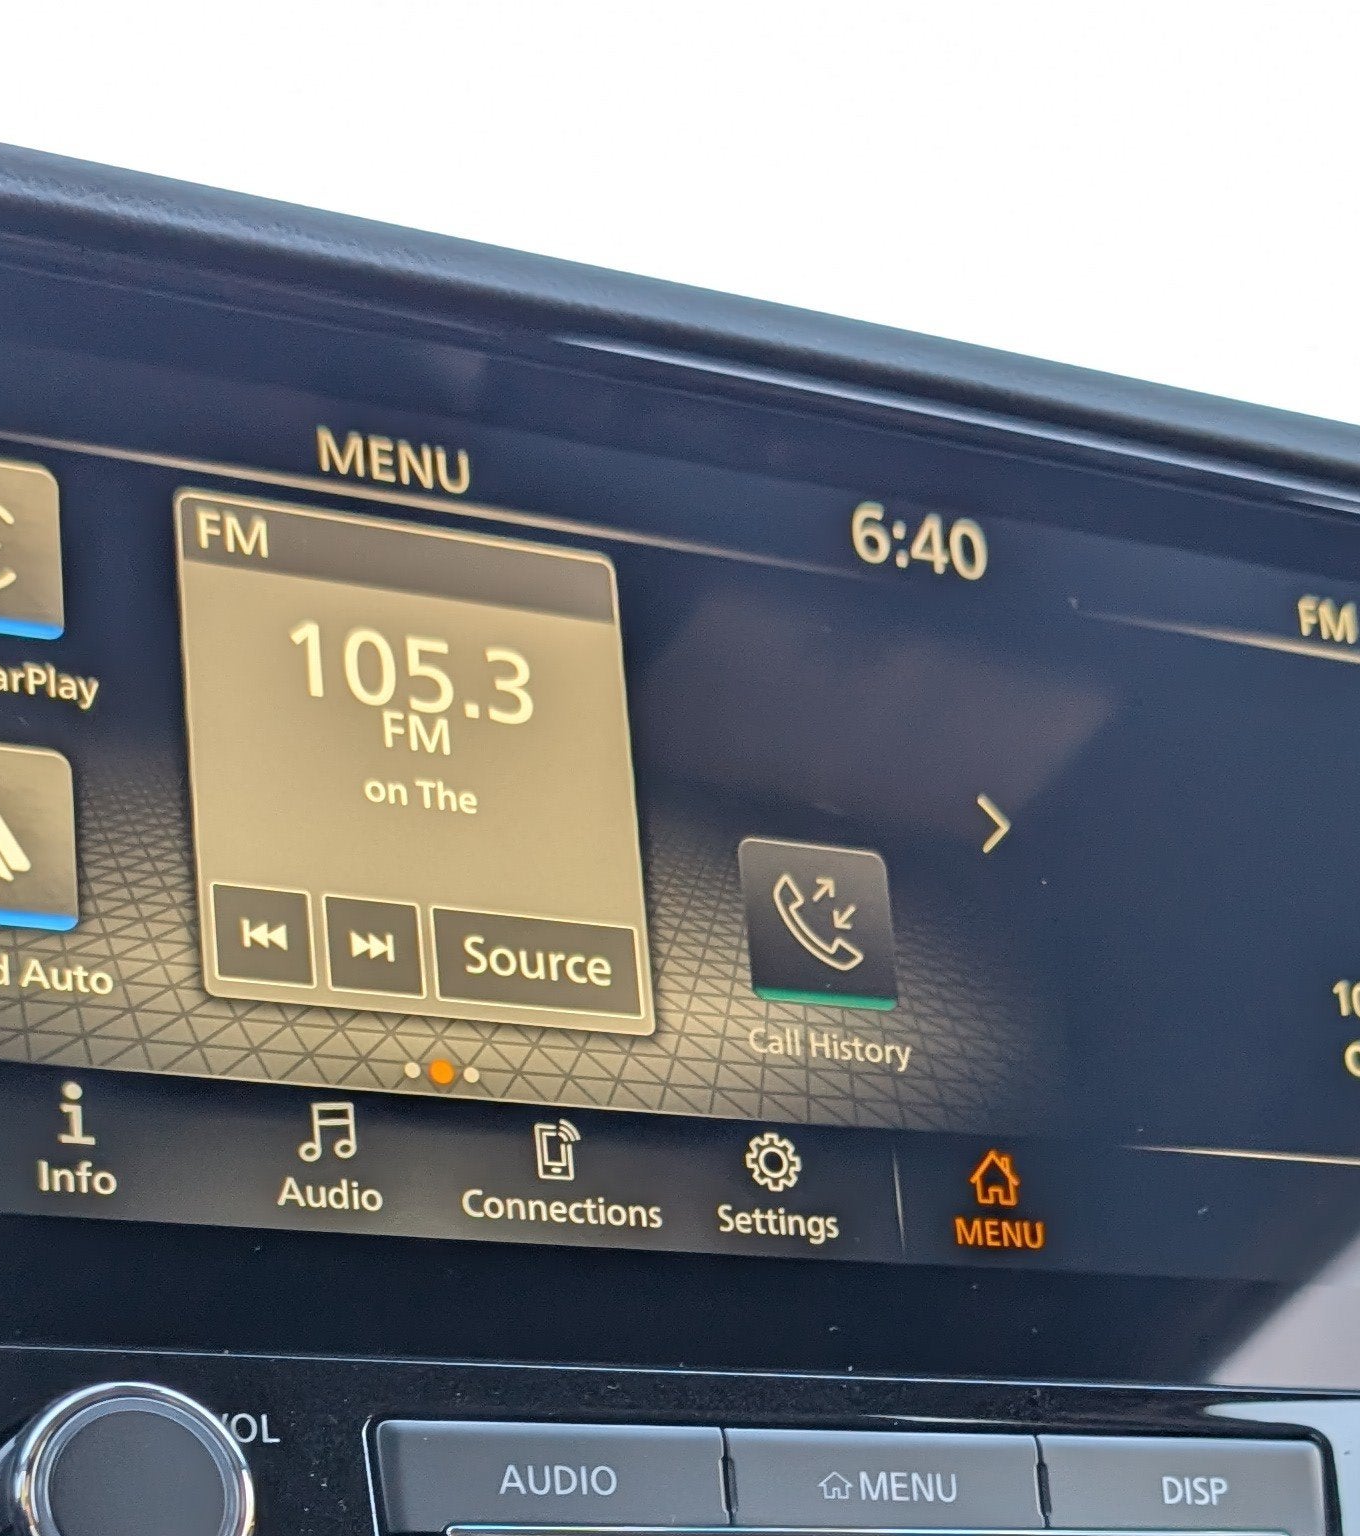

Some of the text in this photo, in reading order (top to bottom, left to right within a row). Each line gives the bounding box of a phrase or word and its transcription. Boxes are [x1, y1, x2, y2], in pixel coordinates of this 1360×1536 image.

[317, 425, 471, 494] MENU
[196, 509, 270, 561] FM
[851, 501, 988, 581] 6:40
[1297, 596, 1358, 646] FM
[289, 620, 535, 726] 105.3
[383, 711, 451, 757] FM
[364, 777, 478, 815] on The
[20, 951, 114, 997] Auto
[465, 935, 613, 988] Source
[748, 1026, 912, 1073] Call History
[37, 1158, 118, 1197] Info
[277, 1176, 384, 1214] Audio
[461, 1188, 664, 1230] Connections
[717, 1203, 840, 1245] Settings
[954, 1216, 1045, 1250] MENU
[499, 1463, 619, 1498] AUDIO
[859, 1470, 959, 1504] MENU
[1161, 1475, 1229, 1508] DISP
